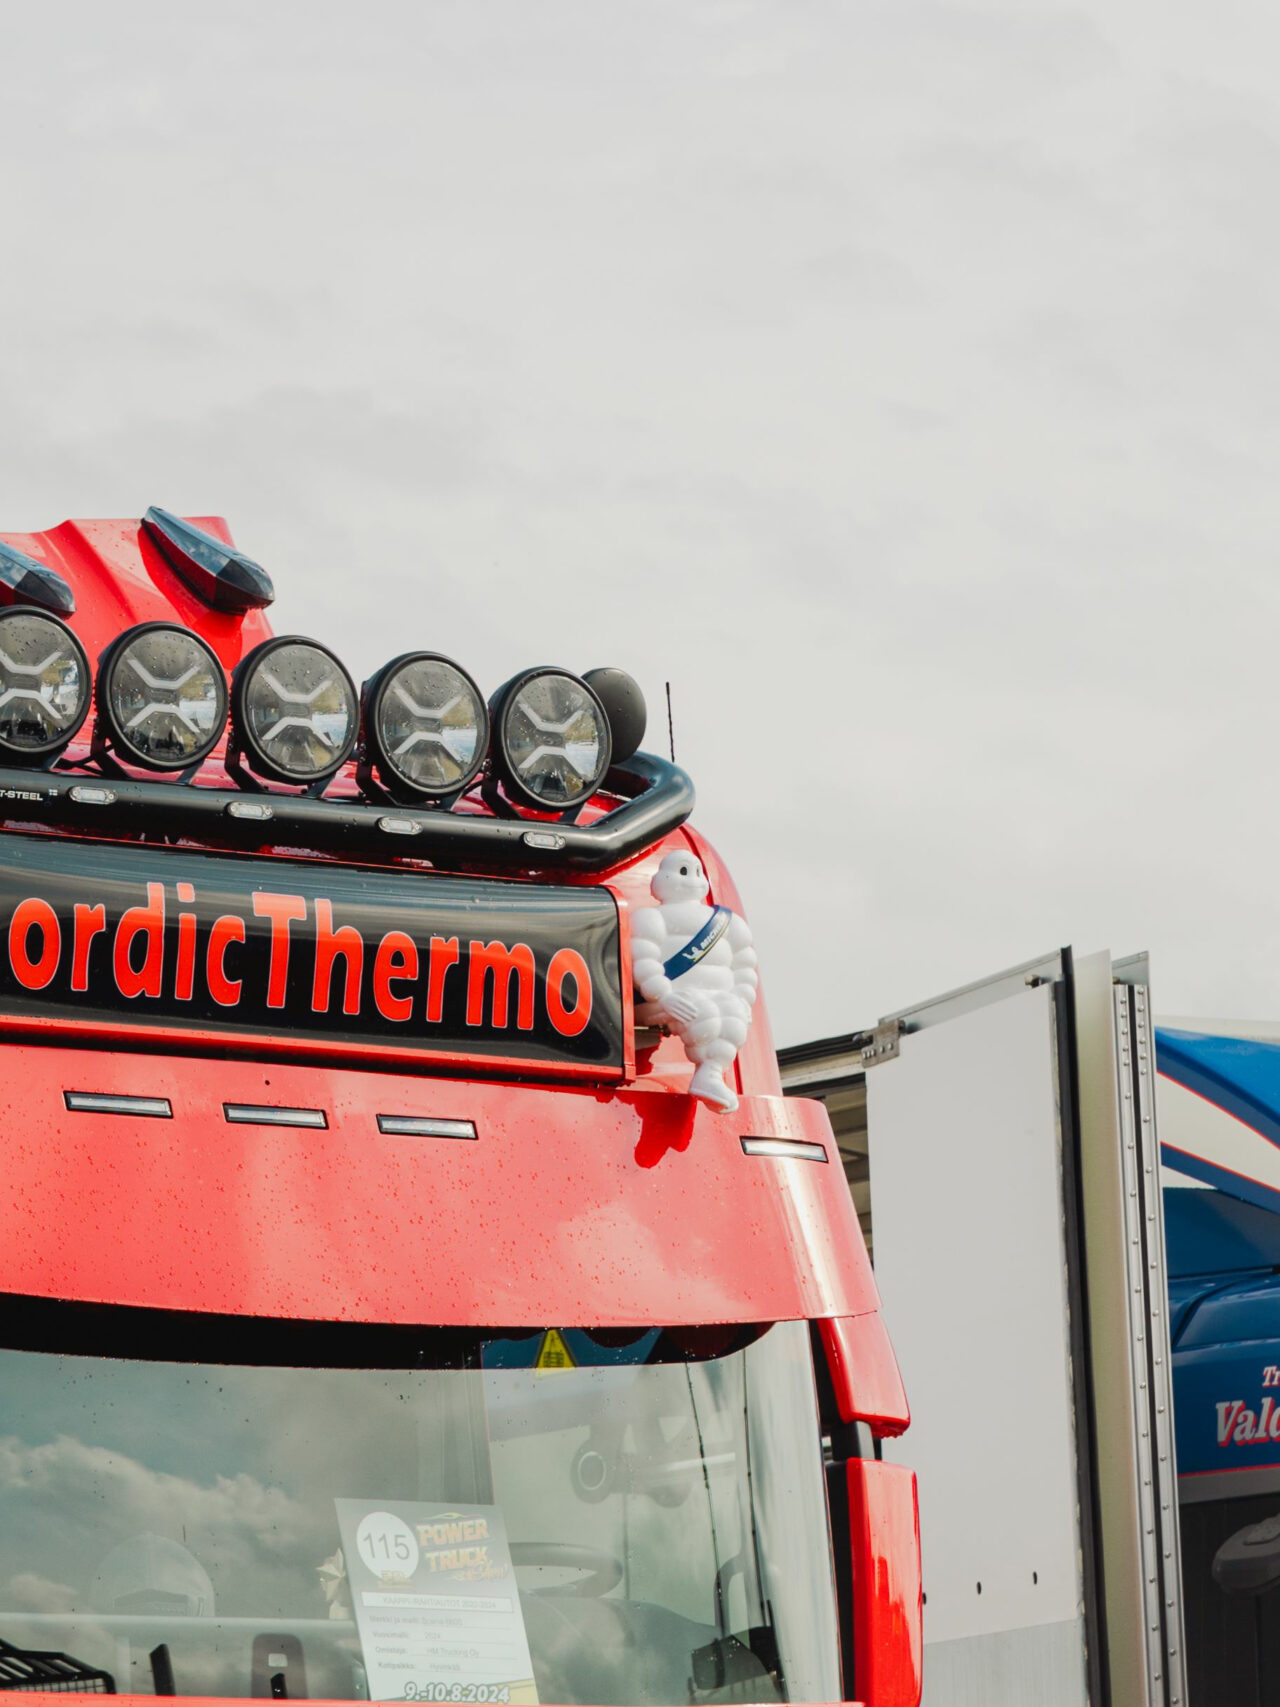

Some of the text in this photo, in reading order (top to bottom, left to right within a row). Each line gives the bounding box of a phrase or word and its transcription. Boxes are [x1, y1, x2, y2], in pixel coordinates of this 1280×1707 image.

[363, 1532, 411, 1561] 115
[416, 1518, 491, 1547] POWER
[425, 1546, 488, 1573] TRUCK
[404, 1681, 510, 1704] 9.-10.8.2024
